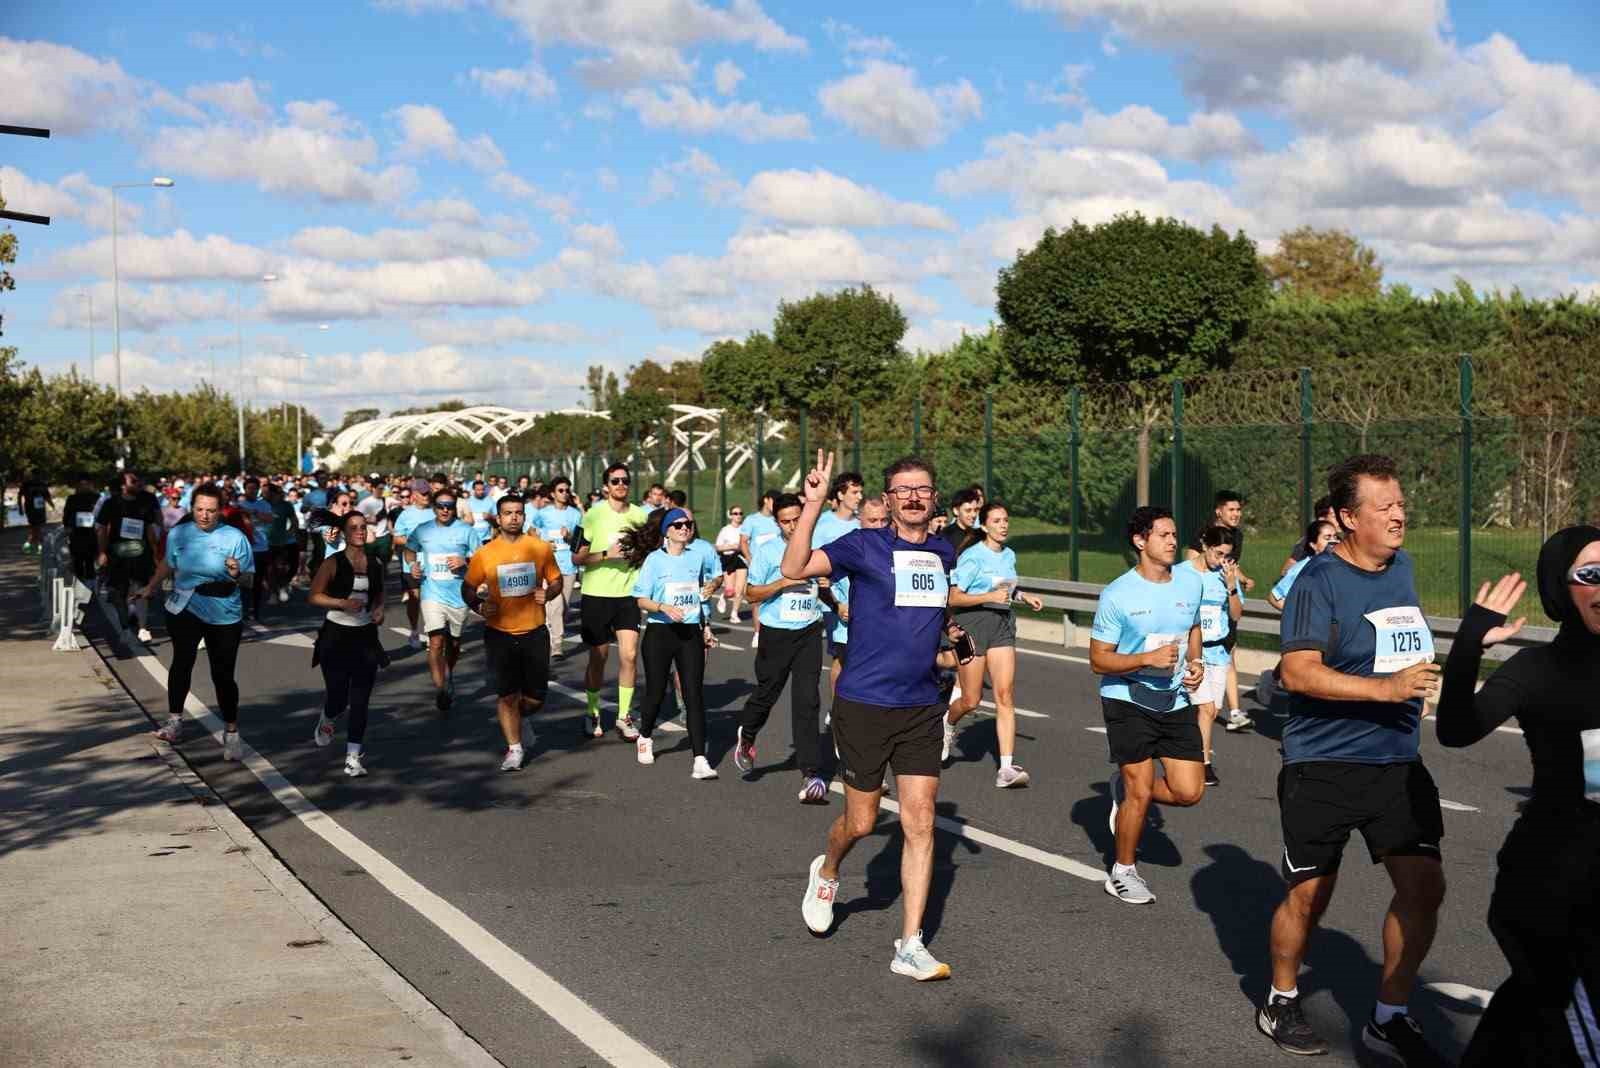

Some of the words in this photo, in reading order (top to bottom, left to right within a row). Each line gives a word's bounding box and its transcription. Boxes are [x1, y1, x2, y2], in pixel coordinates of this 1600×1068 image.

[507, 575, 529, 587] 4909
[912, 573, 935, 591] 605
[673, 594, 693, 606] 2344
[790, 599, 812, 611] 2146
[1391, 631, 1421, 653] 1275
